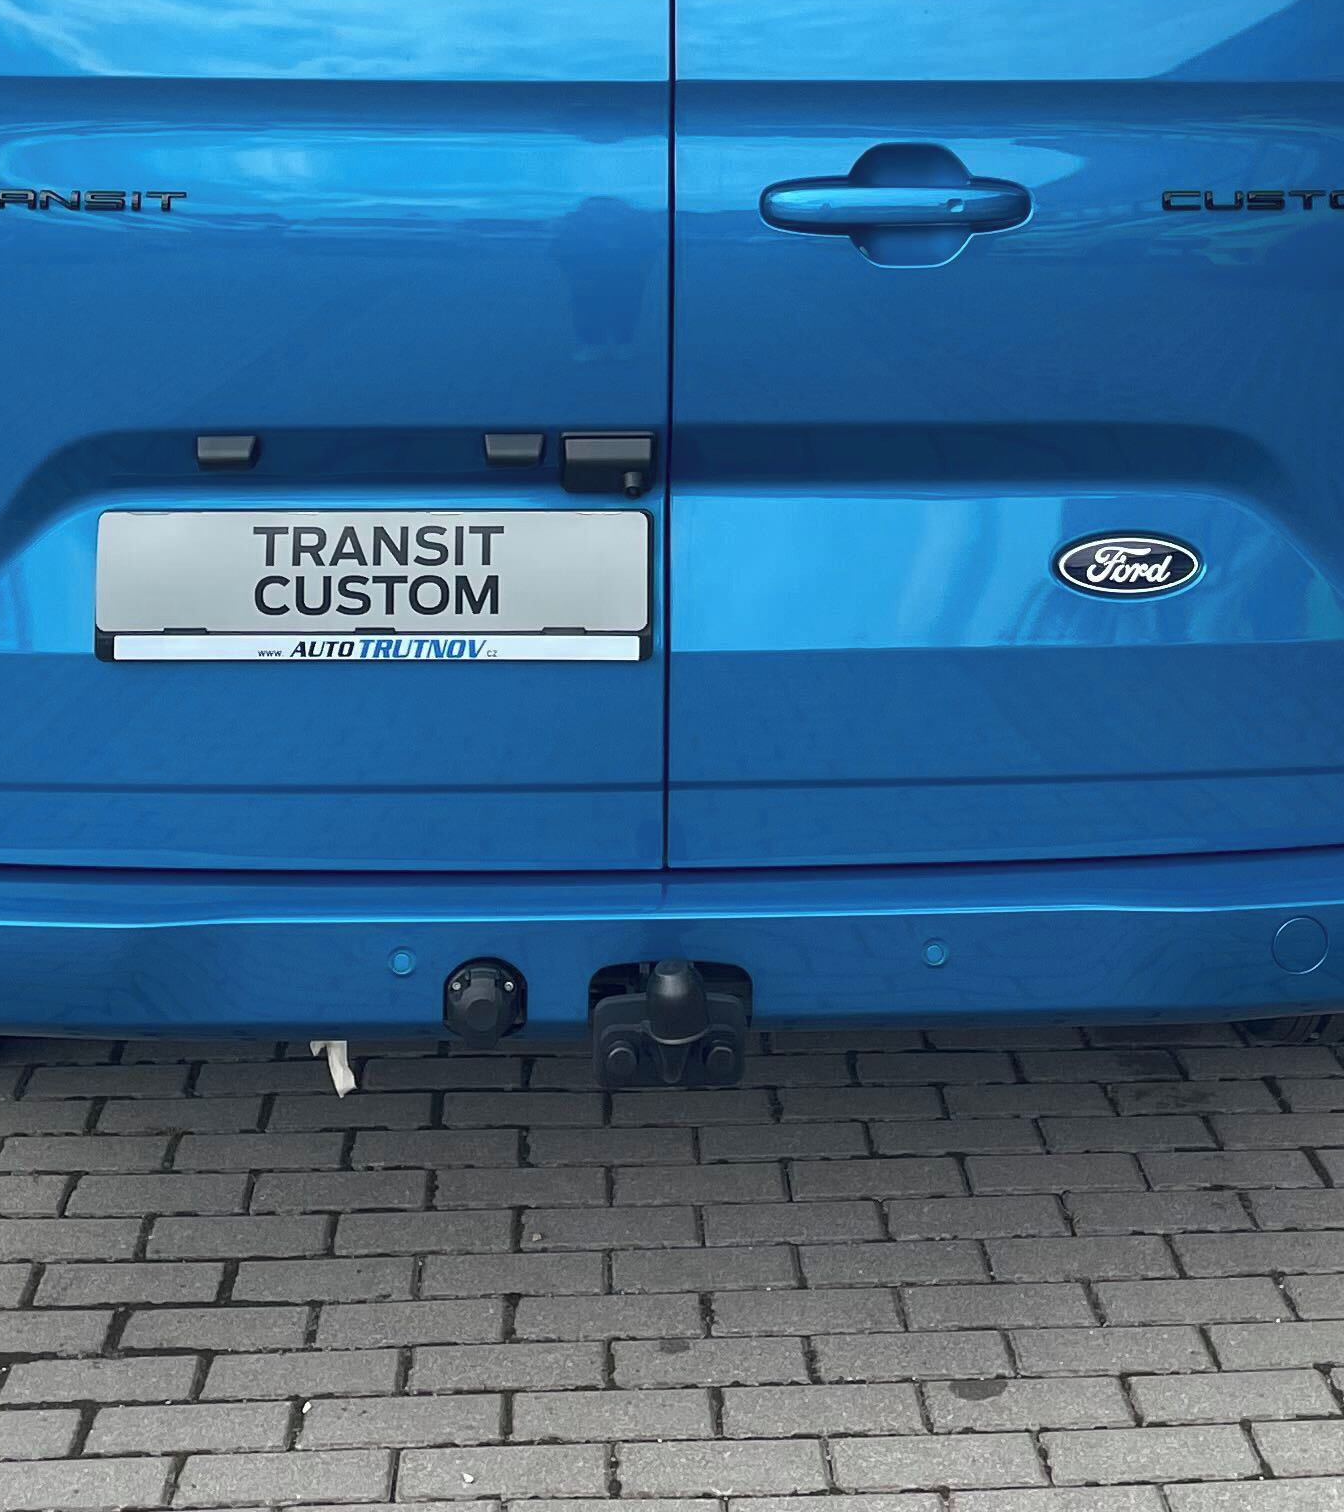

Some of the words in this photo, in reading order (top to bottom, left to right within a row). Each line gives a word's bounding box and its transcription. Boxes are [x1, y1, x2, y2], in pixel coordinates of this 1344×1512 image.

[253, 525, 505, 567] TRANSIT
[1086, 546, 1173, 583] Ford
[254, 575, 499, 616] CUSTOM
